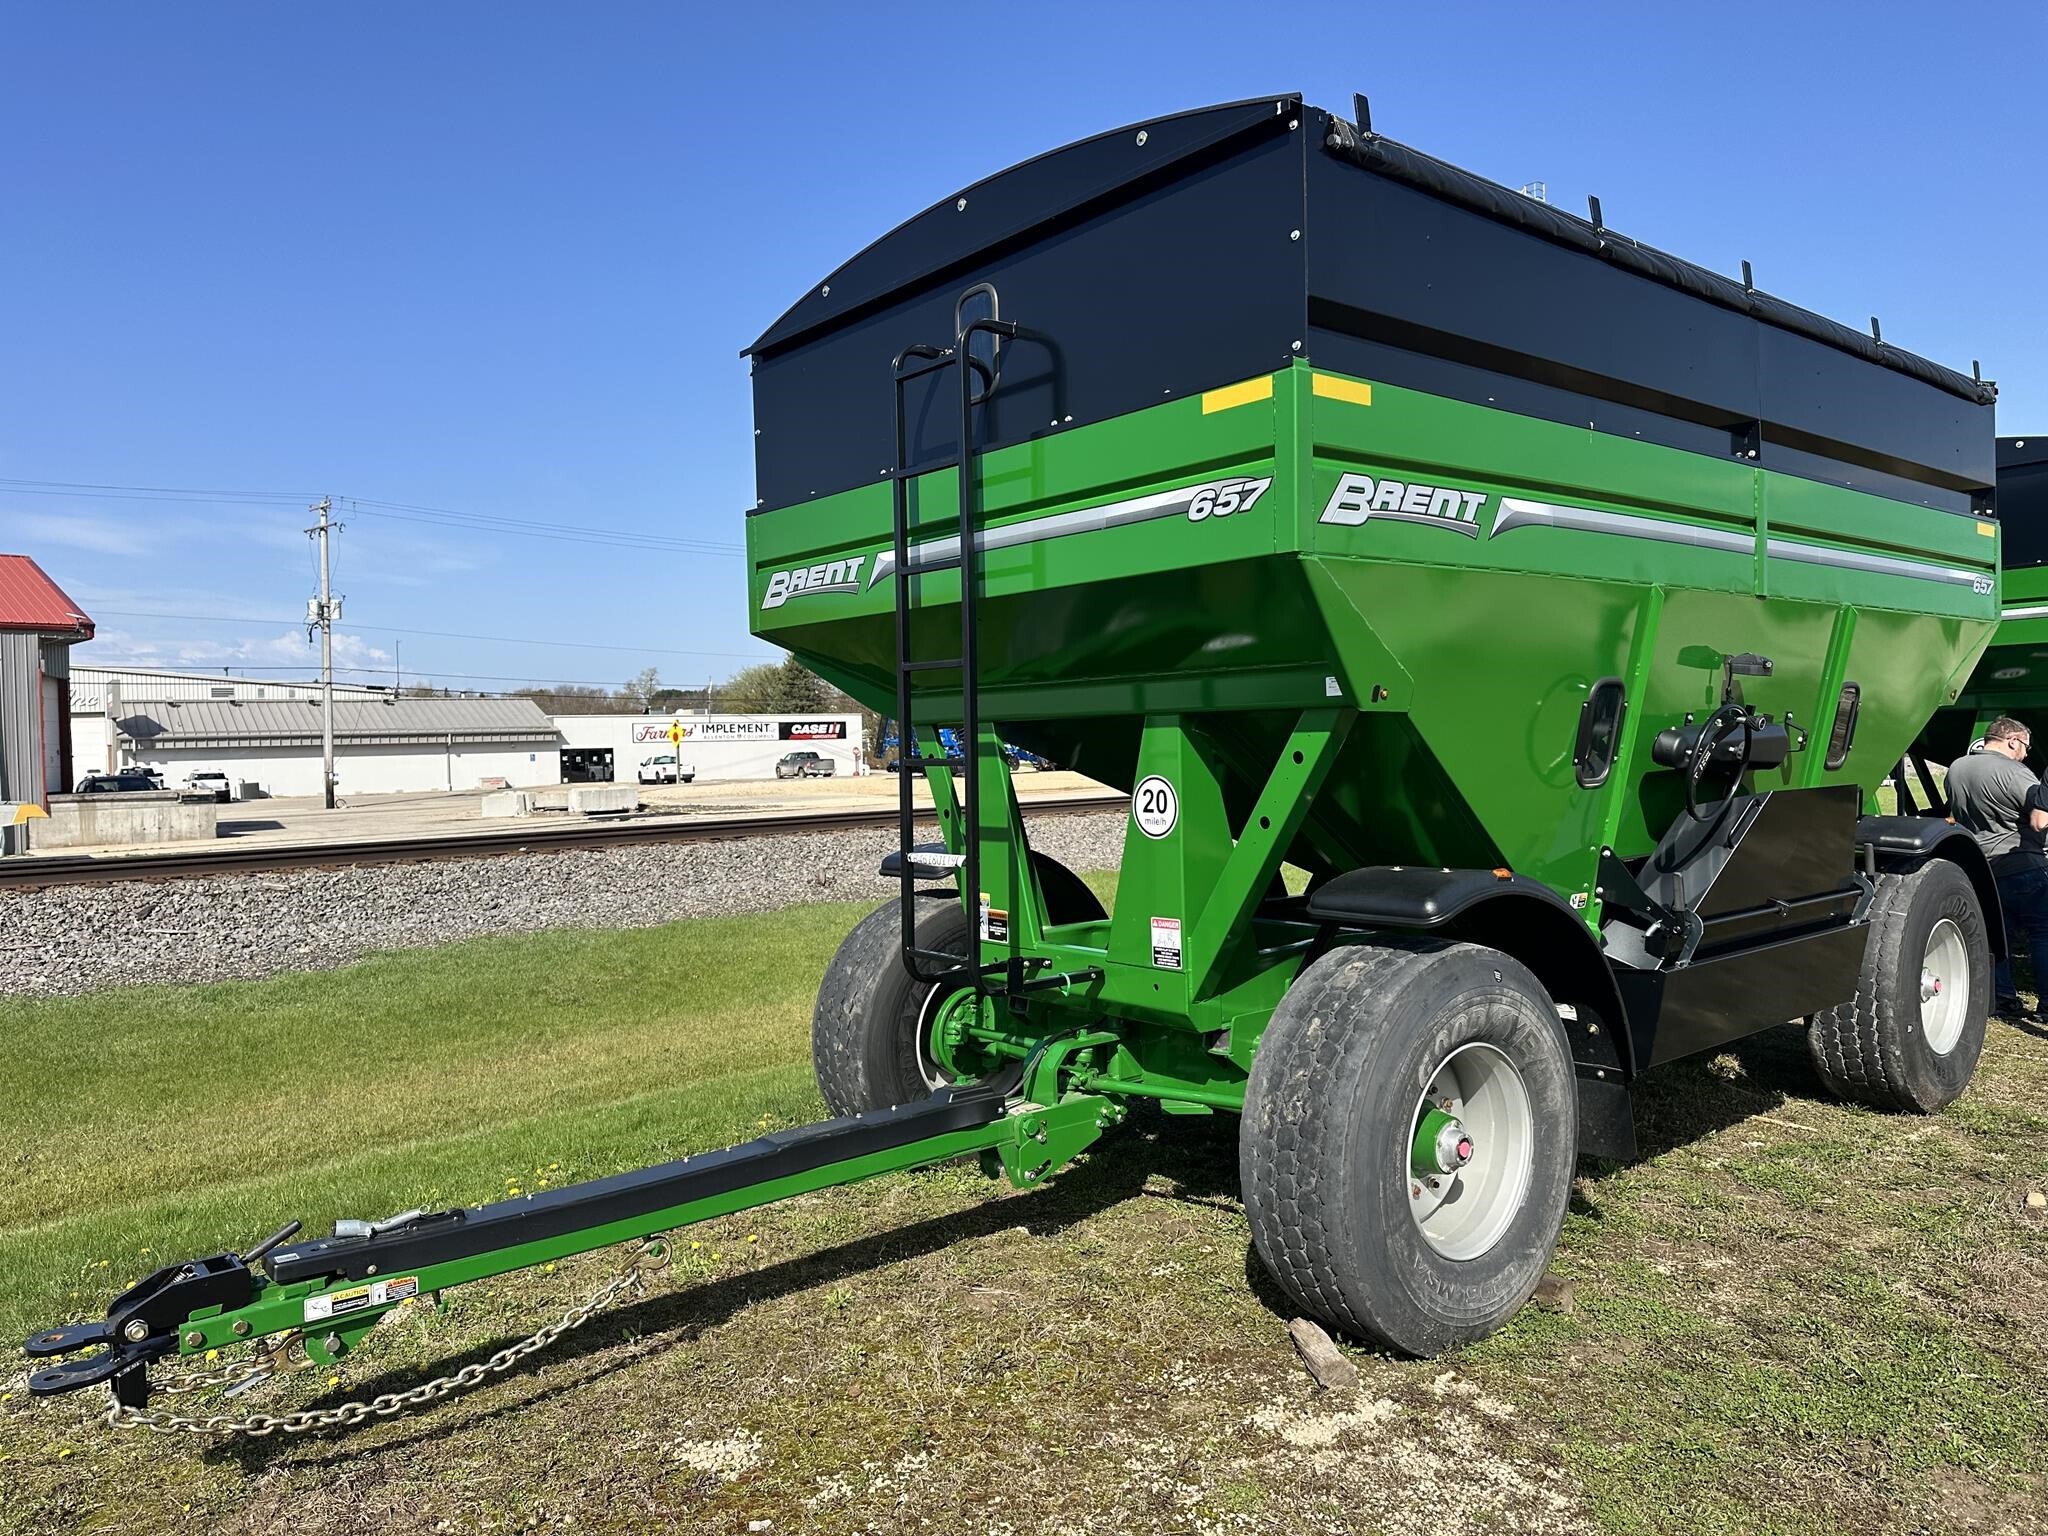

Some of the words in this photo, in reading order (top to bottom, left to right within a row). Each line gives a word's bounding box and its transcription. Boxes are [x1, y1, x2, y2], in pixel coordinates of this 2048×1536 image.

[1187, 477, 1274, 522] 657
[1317, 472, 1488, 526] BRENT
[760, 555, 866, 611] BRENT
[1973, 576, 1995, 596] 657
[636, 724, 697, 741] Farrs'
[701, 723, 770, 734] IMPLEMENT
[791, 723, 828, 735] CASE
[1142, 788, 1168, 815] 20
[339, 1287, 368, 1300] CAUTION
